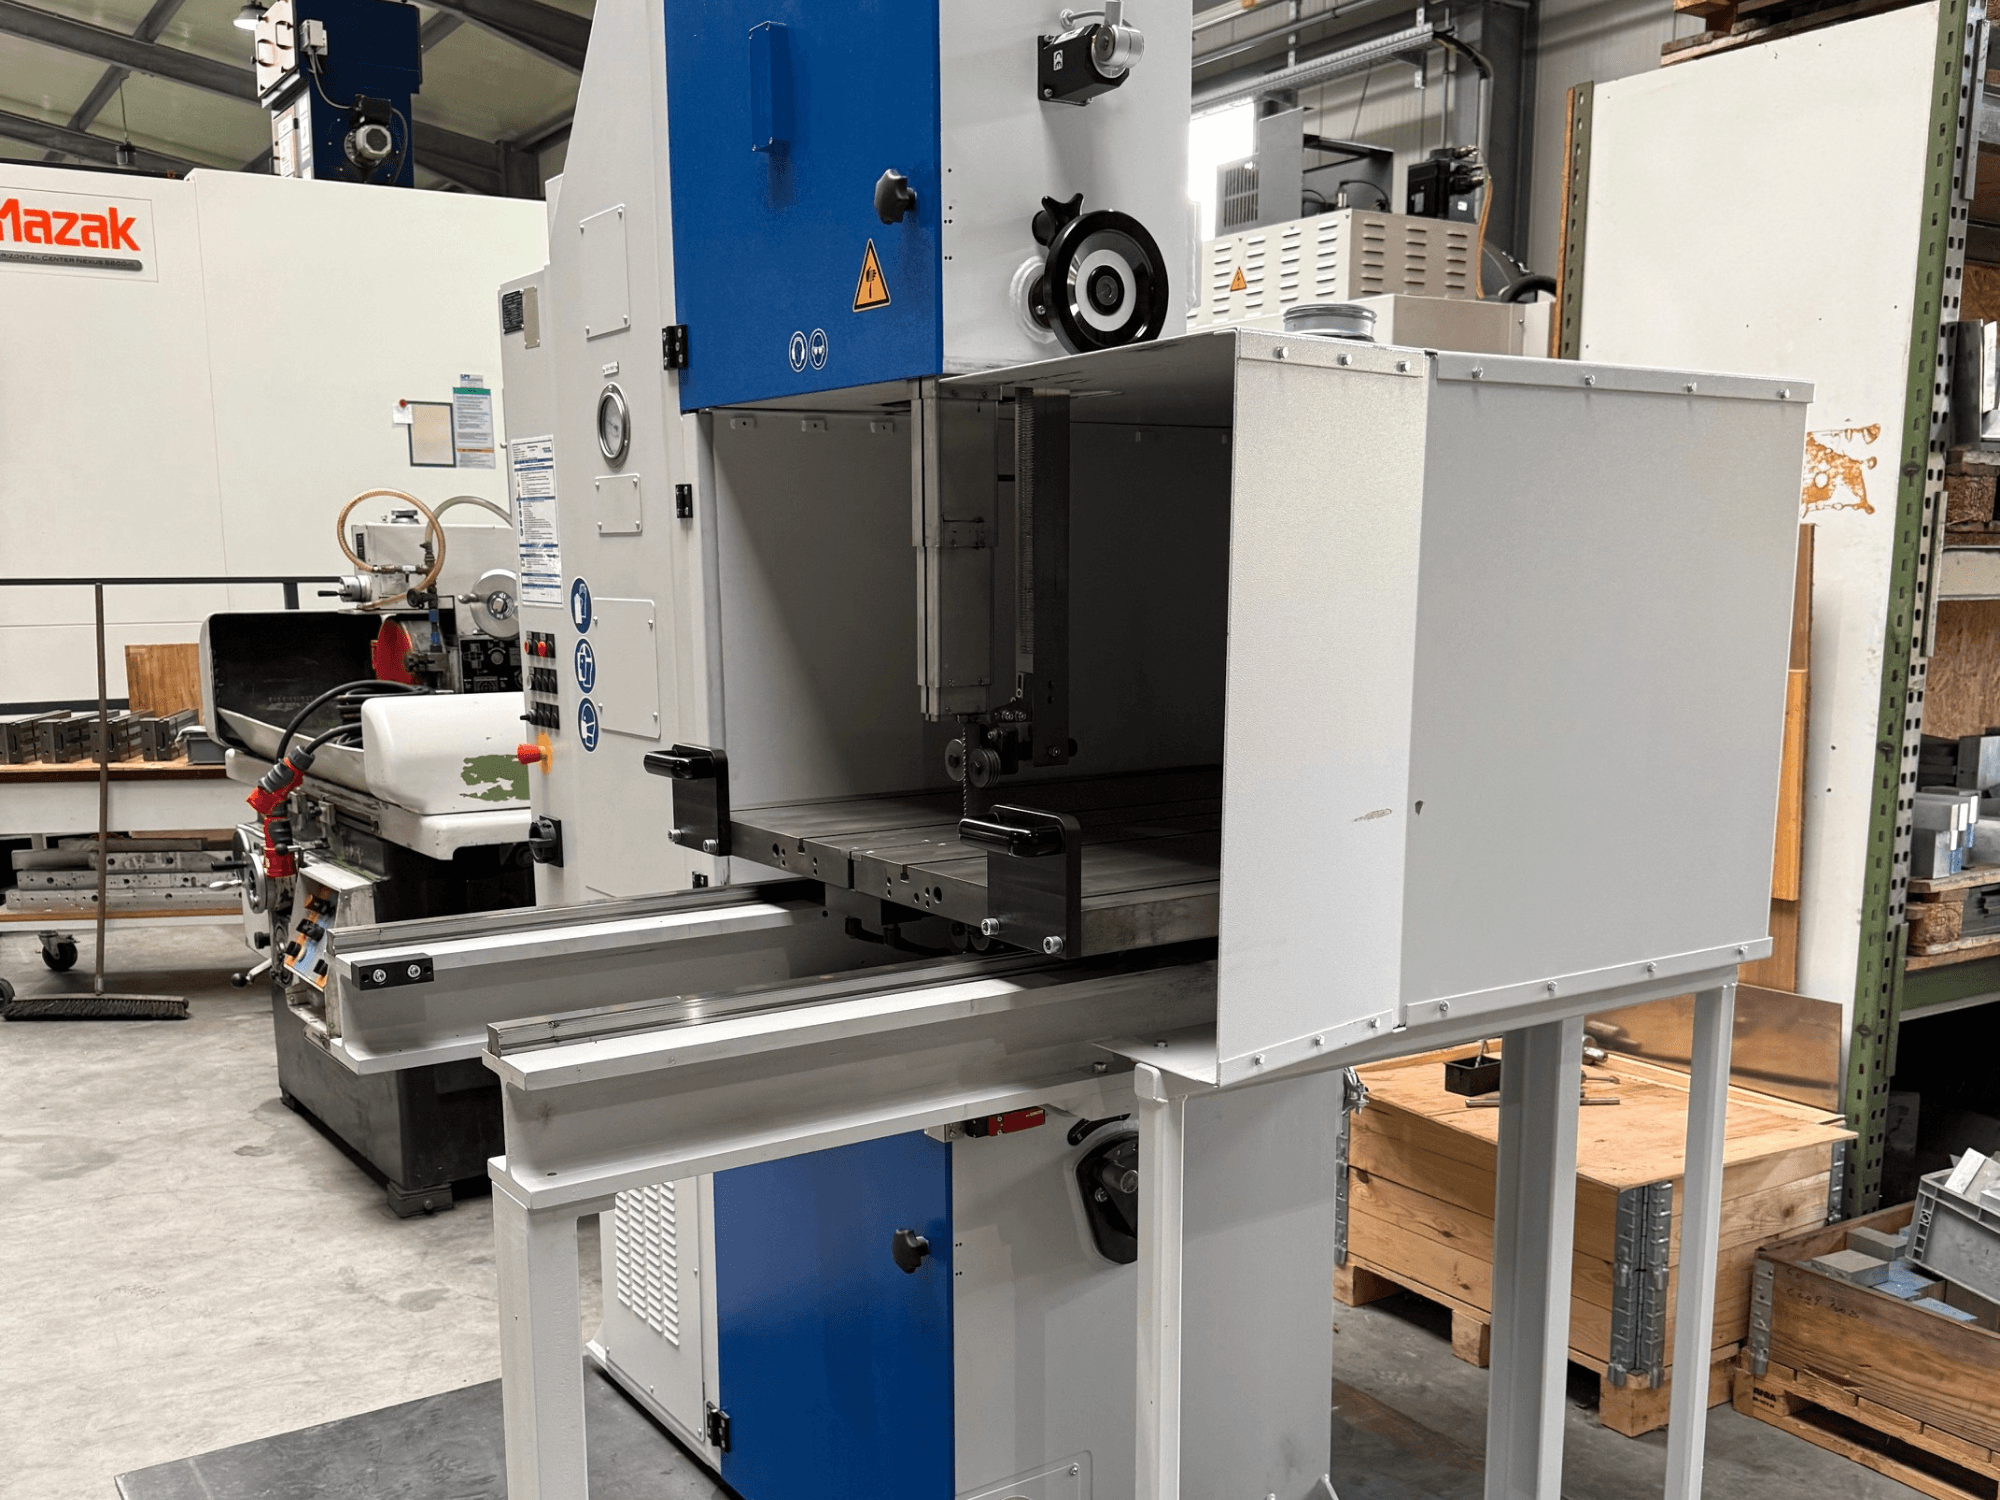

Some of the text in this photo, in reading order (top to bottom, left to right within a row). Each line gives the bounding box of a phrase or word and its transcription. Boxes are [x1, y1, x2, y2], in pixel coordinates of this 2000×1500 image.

[0, 198, 141, 251] Mazak
[0, 253, 41, 262] RIZONTAL
[42, 255, 75, 263] CENTER
[76, 258, 104, 266] NEXUS
